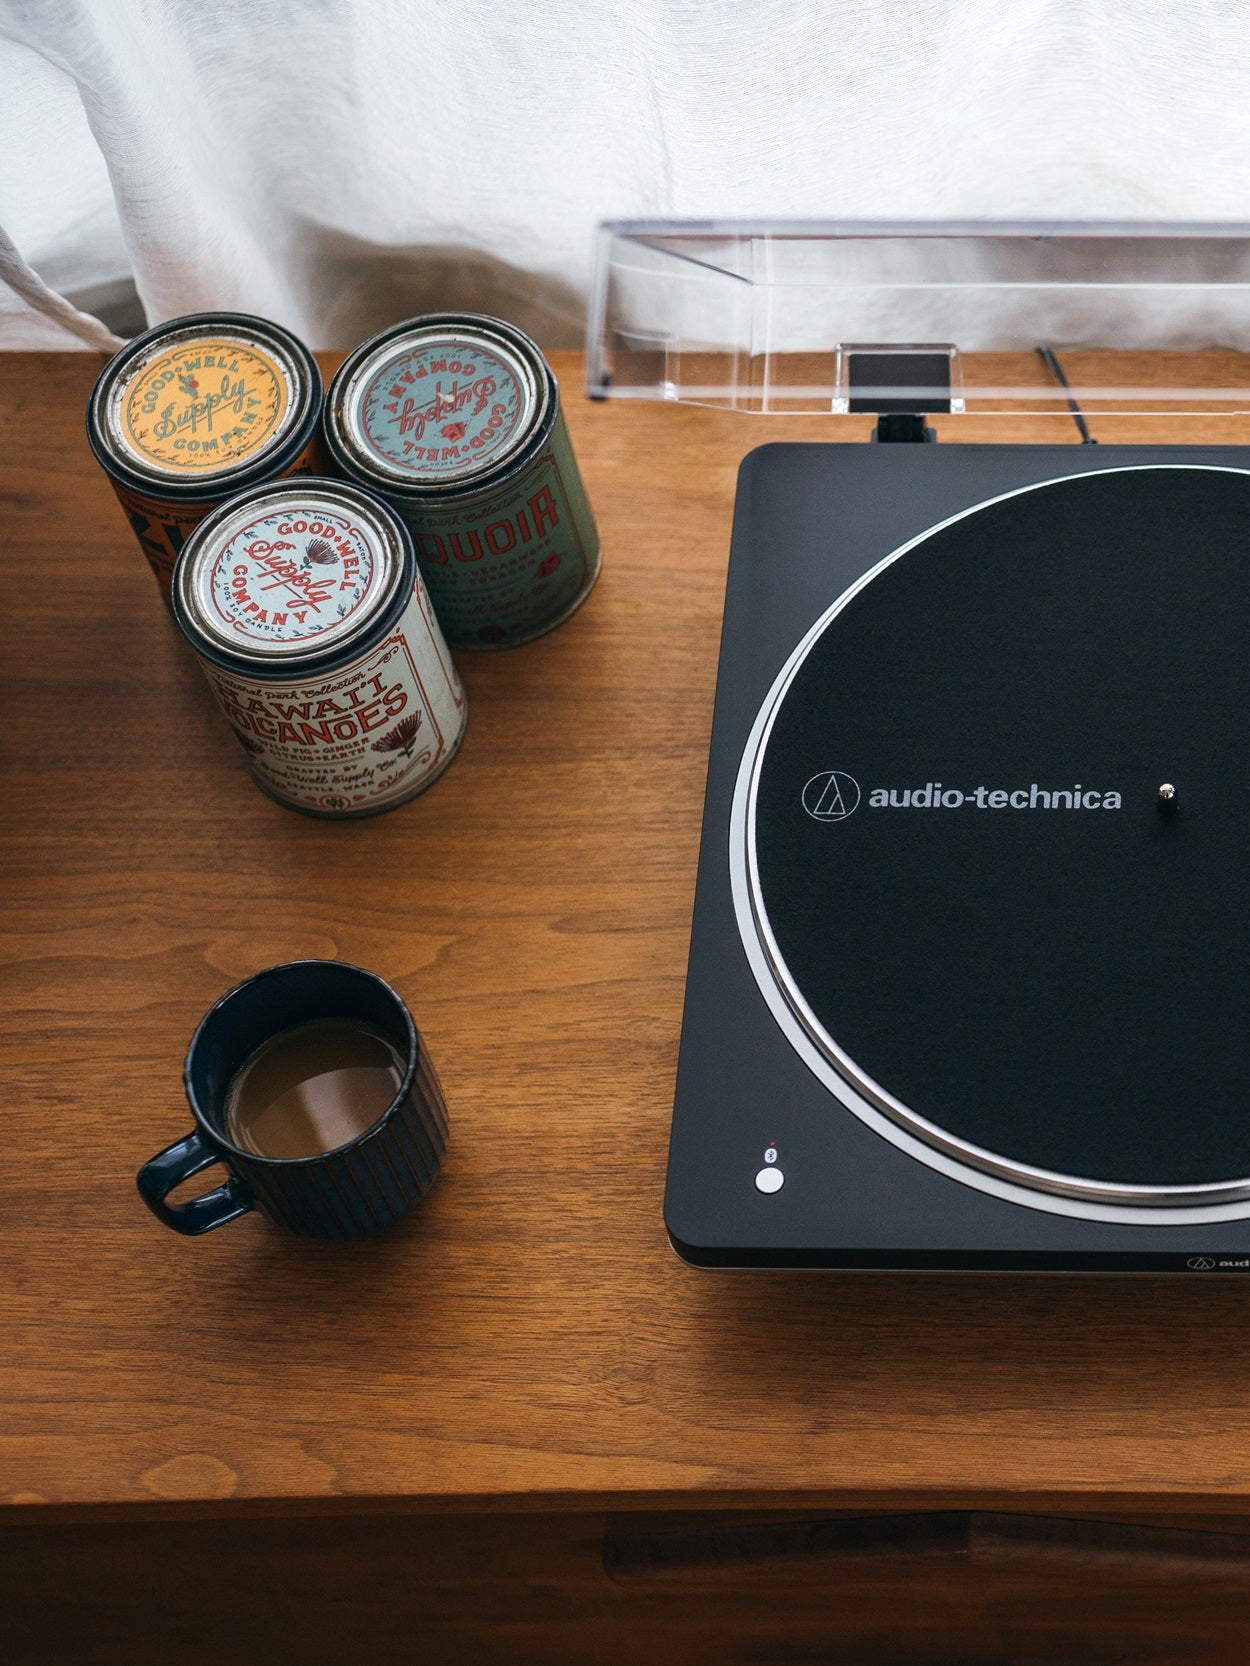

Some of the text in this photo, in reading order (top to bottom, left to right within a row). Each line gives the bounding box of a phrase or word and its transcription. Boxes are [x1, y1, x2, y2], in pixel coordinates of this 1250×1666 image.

[141, 370, 176, 414] GOOD
[183, 356, 239, 373] WELL
[153, 375, 257, 442] Supply
[383, 359, 476, 414] COMPANY
[387, 375, 498, 442] Supply
[173, 398, 262, 452] COMPANY
[402, 440, 461, 461] WELL
[468, 403, 507, 450] GOOD
[243, 540, 337, 613] Supply
[277, 520, 360, 591] GOOD WELL
[229, 603, 243, 617] SOY
[245, 618, 283, 632] CANDLE
[232, 564, 308, 626] COMPANY
[301, 671, 367, 698] Collection
[322, 737, 370, 754] GINGER
[322, 747, 366, 760] EARTH
[868, 782, 1123, 810] audio-technica
